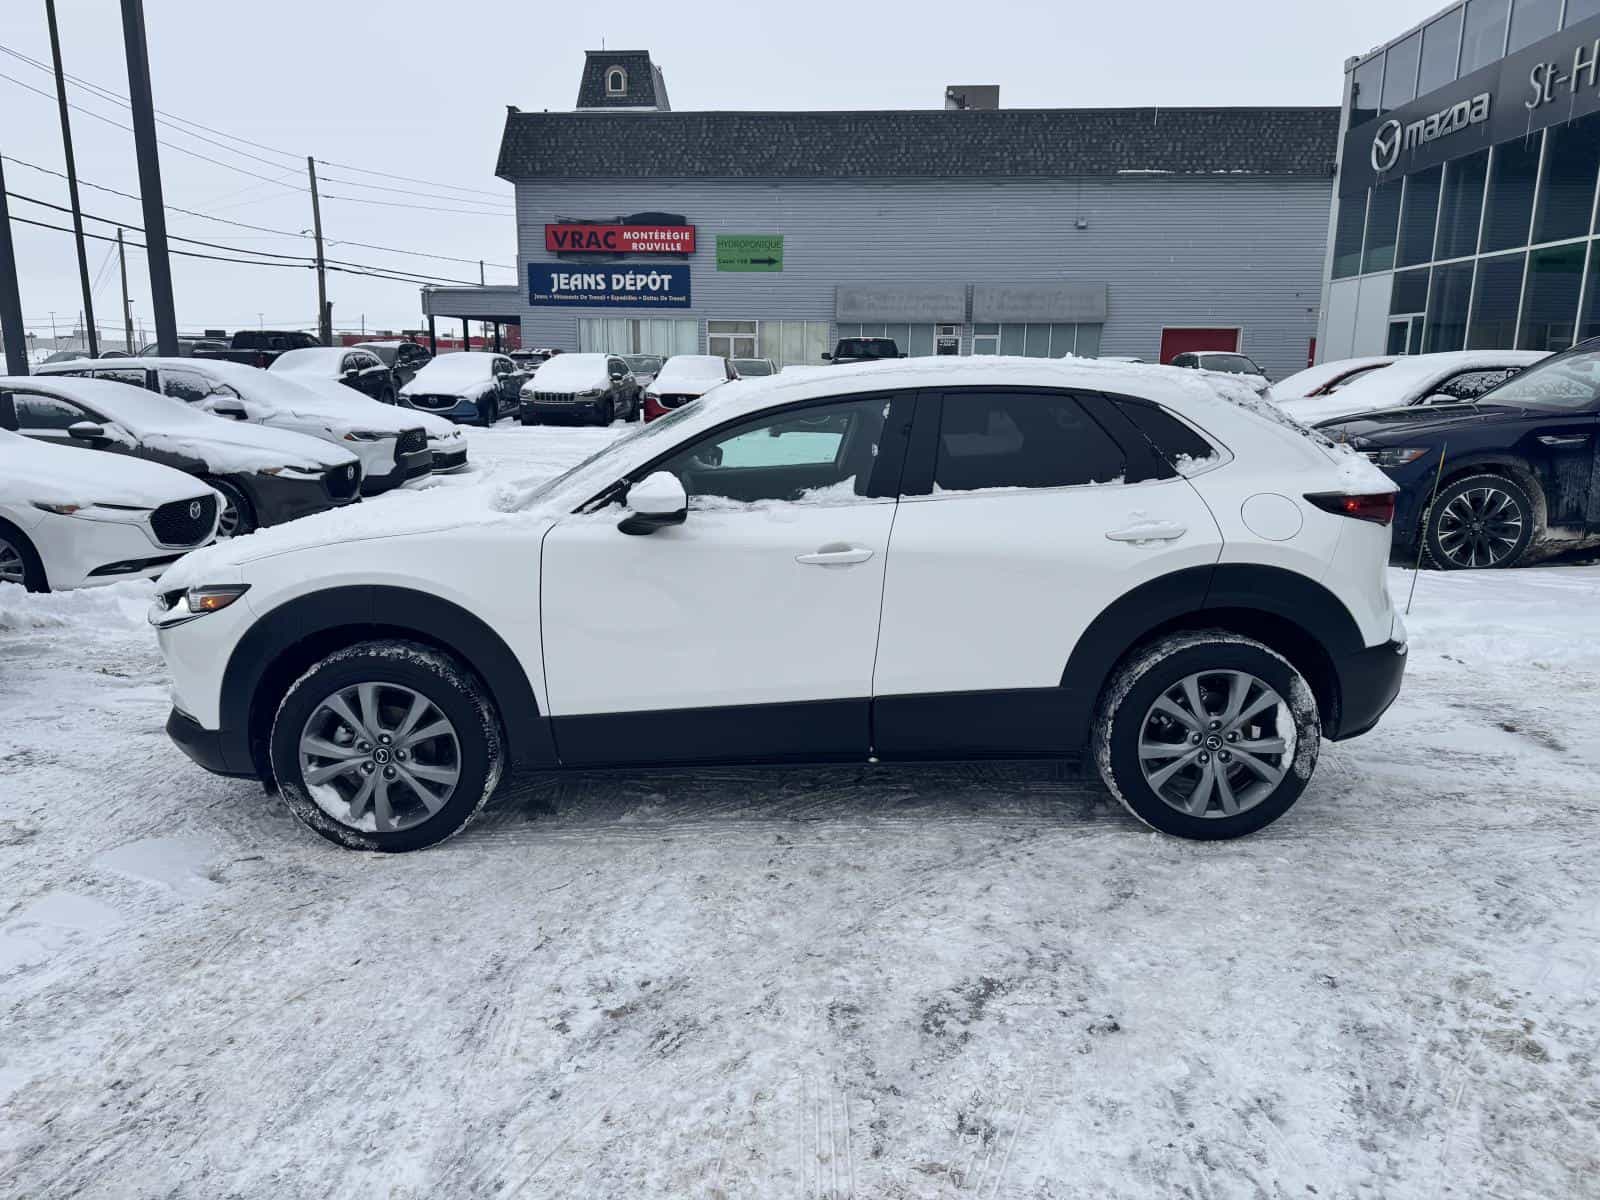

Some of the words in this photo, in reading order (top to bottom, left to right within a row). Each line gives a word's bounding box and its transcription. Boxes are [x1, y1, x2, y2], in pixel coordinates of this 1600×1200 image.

[1525, 38, 1600, 109] St-H
[1404, 92, 1491, 149] mazda
[552, 231, 617, 249] VRAC
[623, 229, 690, 241] MONTÉRÉGIE
[632, 242, 681, 252] ROUVILLE
[550, 272, 607, 293] JEANS
[611, 270, 673, 291] DÉPÔT
